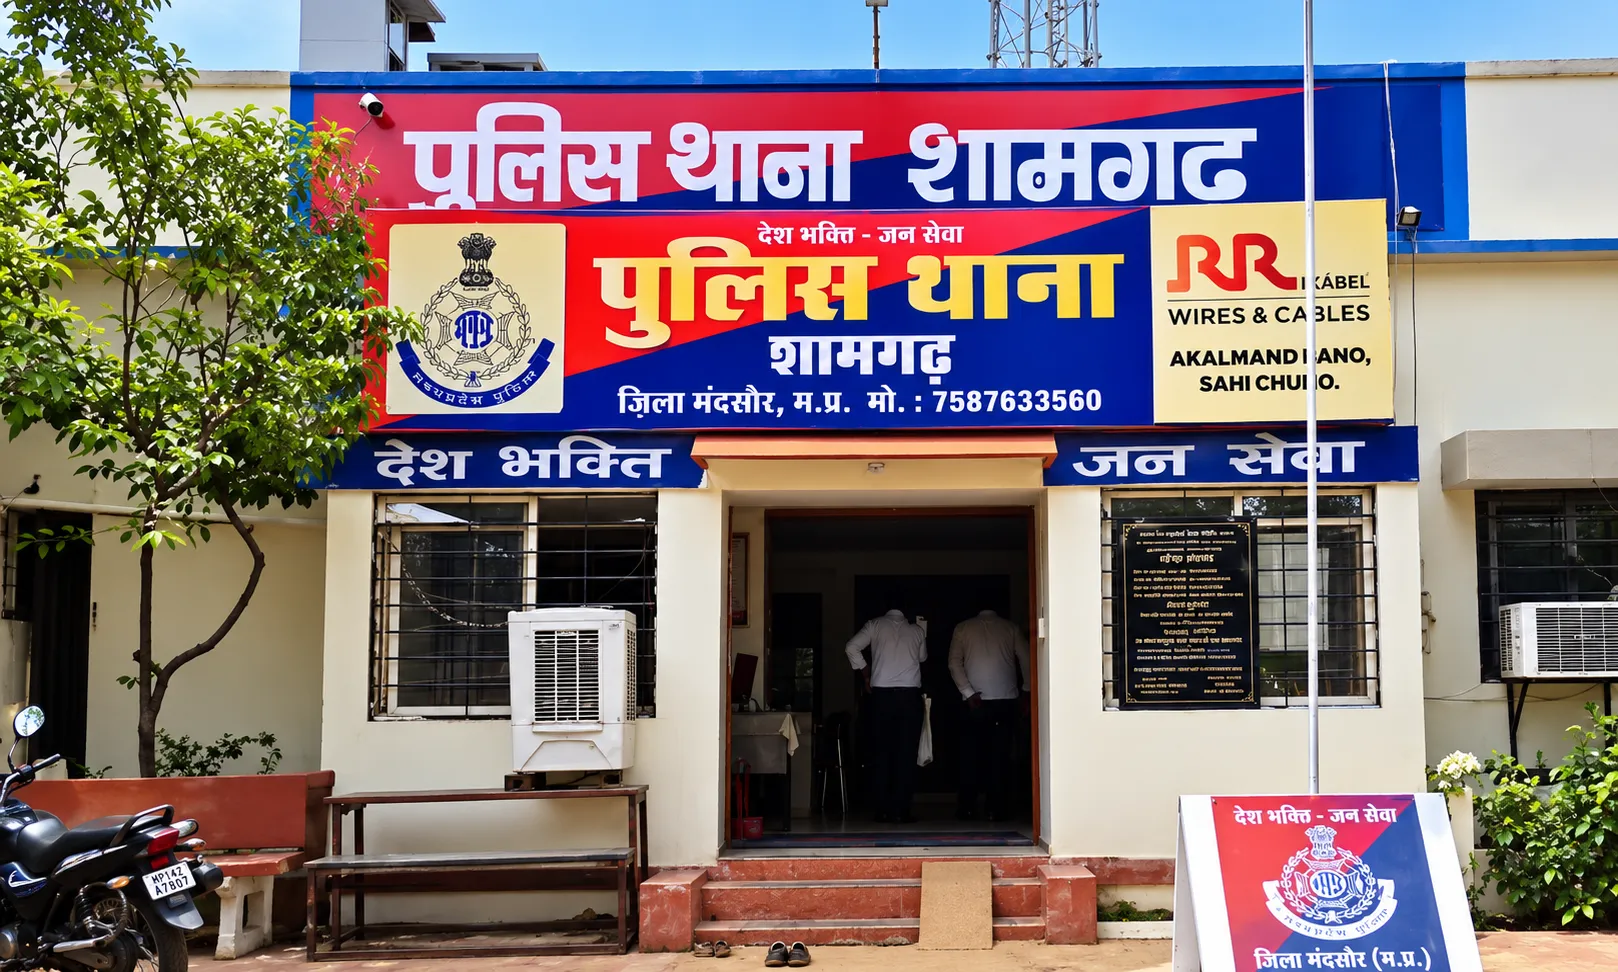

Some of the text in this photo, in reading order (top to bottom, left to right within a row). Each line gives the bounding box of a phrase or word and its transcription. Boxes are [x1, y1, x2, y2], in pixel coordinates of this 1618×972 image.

[667, 122, 863, 201] थाना
[907, 123, 1258, 202] शामगढ
[758, 221, 793, 244] देश
[801, 221, 855, 243] भक्ति
[878, 226, 917, 243] जन
[922, 221, 963, 243] सेवा
[1168, 233, 1297, 292] RR
[592, 236, 878, 350] पुलिस
[907, 255, 1123, 319] थाना
[1168, 307, 1245, 325] WIRES
[1253, 307, 1266, 323] &
[768, 335, 956, 384] शामगढ़
[1171, 349, 1298, 366] AKALMAND
[1200, 376, 1250, 392] SAHI
[693, 385, 783, 417] मंदसौर,
[793, 393, 849, 413] म.प्र.
[933, 389, 1102, 413] 7587633560
[374, 436, 672, 486] देश भक्ति
[1073, 432, 1366, 476] जन सेवा
[1234, 806, 1262, 824] देश
[1268, 805, 1310, 823] भक्ति
[1328, 808, 1360, 823] जन
[1363, 804, 1396, 822] सेवा
[1254, 947, 1430, 971] जिला मंदसौर (म.प्र.)
